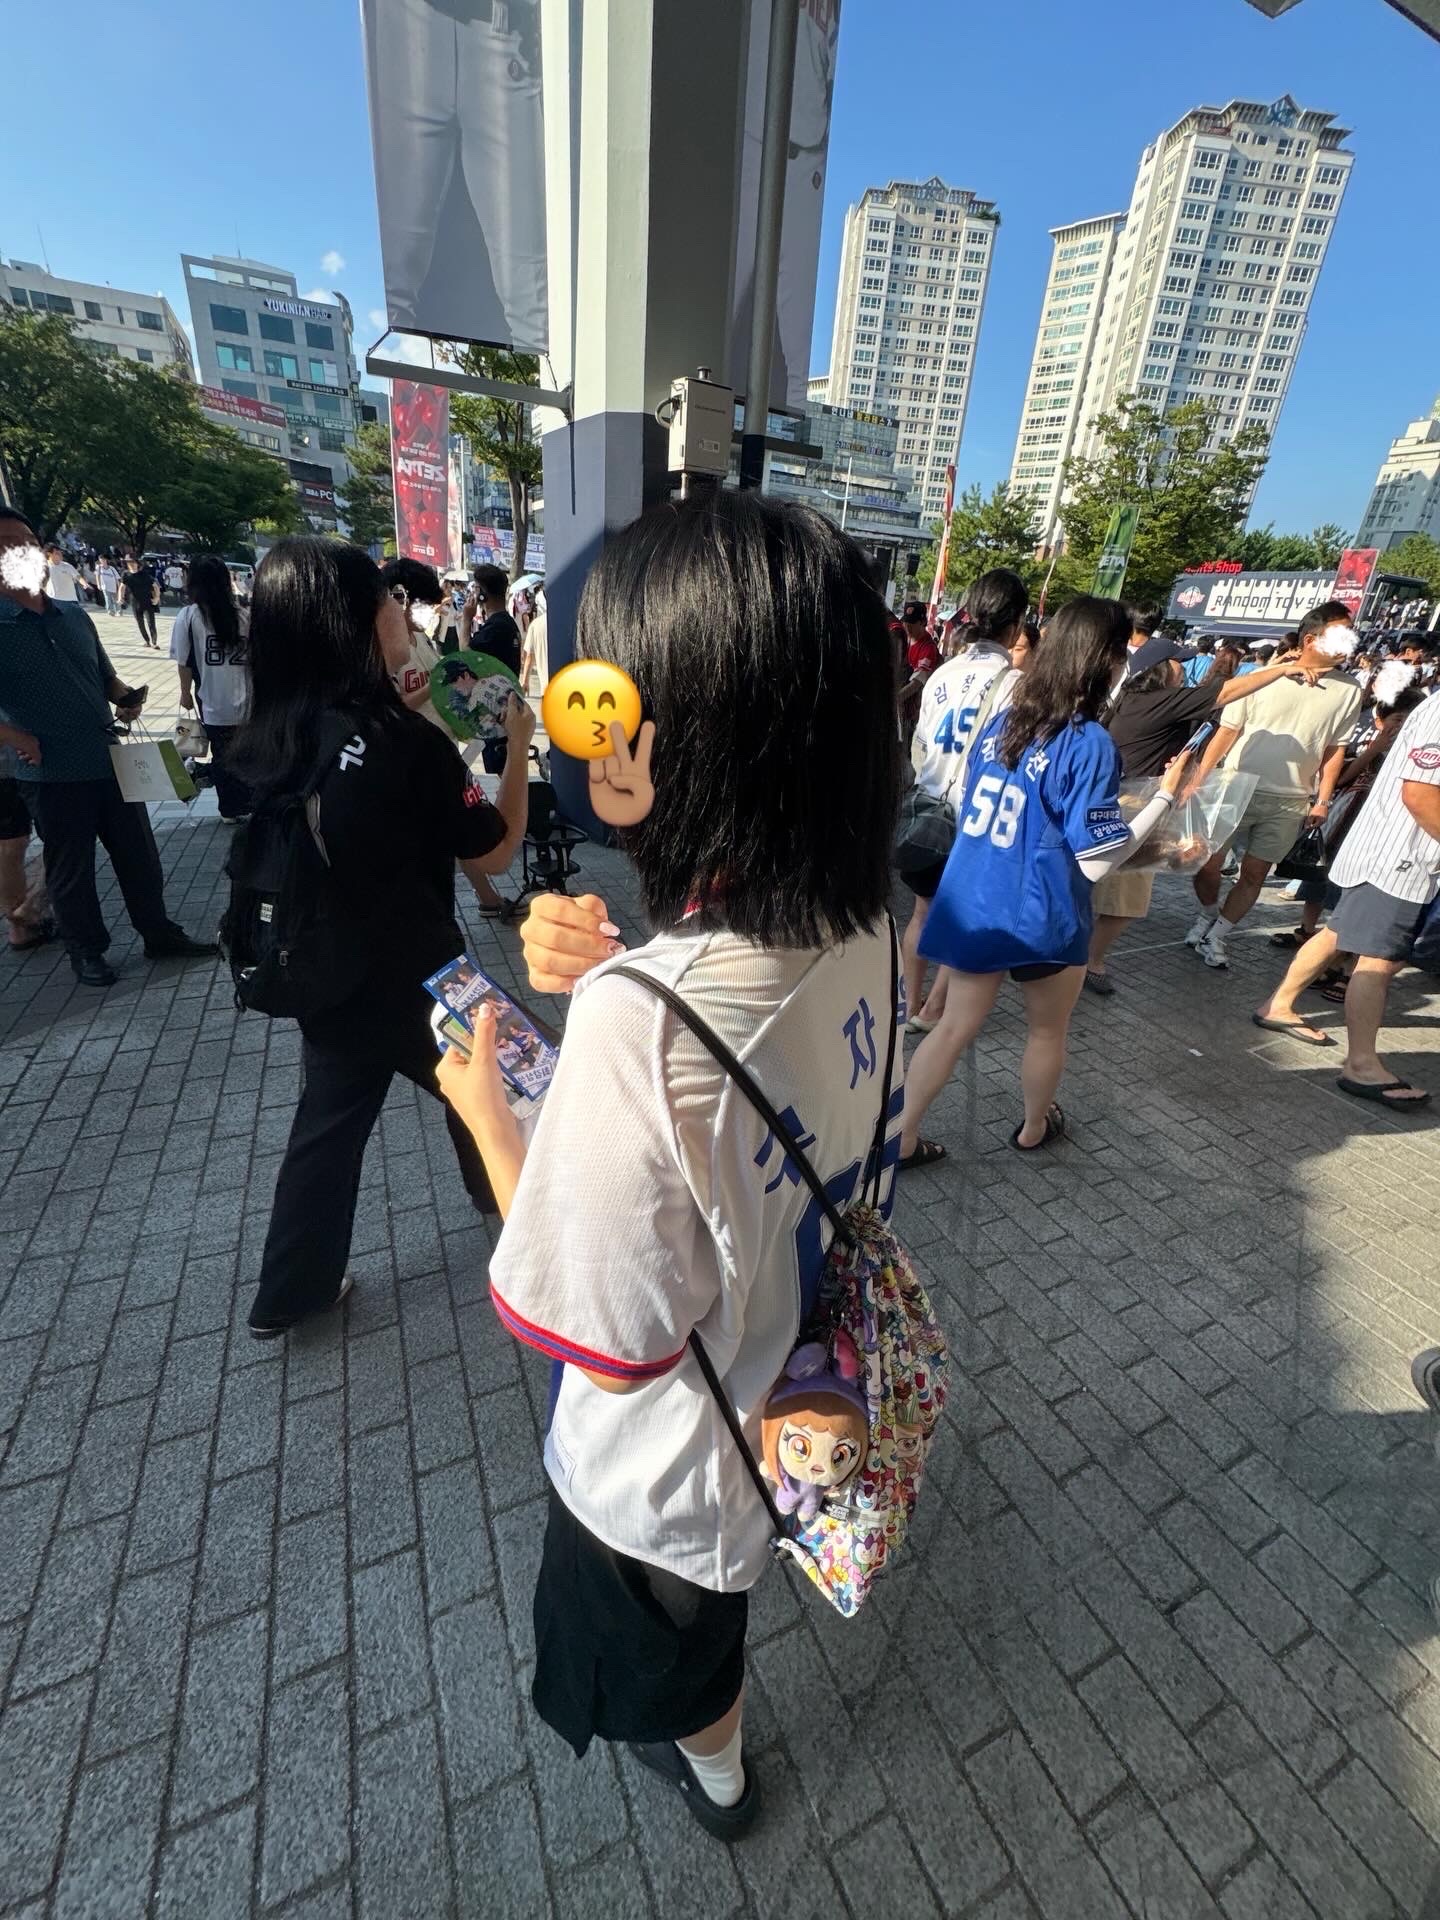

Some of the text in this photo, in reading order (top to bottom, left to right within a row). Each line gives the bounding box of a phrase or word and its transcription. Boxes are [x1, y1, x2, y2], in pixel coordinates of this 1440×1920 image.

[320, 489, 333, 501] PC
[1215, 560, 1243, 575] Shop
[1215, 595, 1271, 608] RANDOM
[1275, 596, 1305, 609] TOY
[934, 708, 980, 754] 45
[963, 774, 1028, 849] 58
